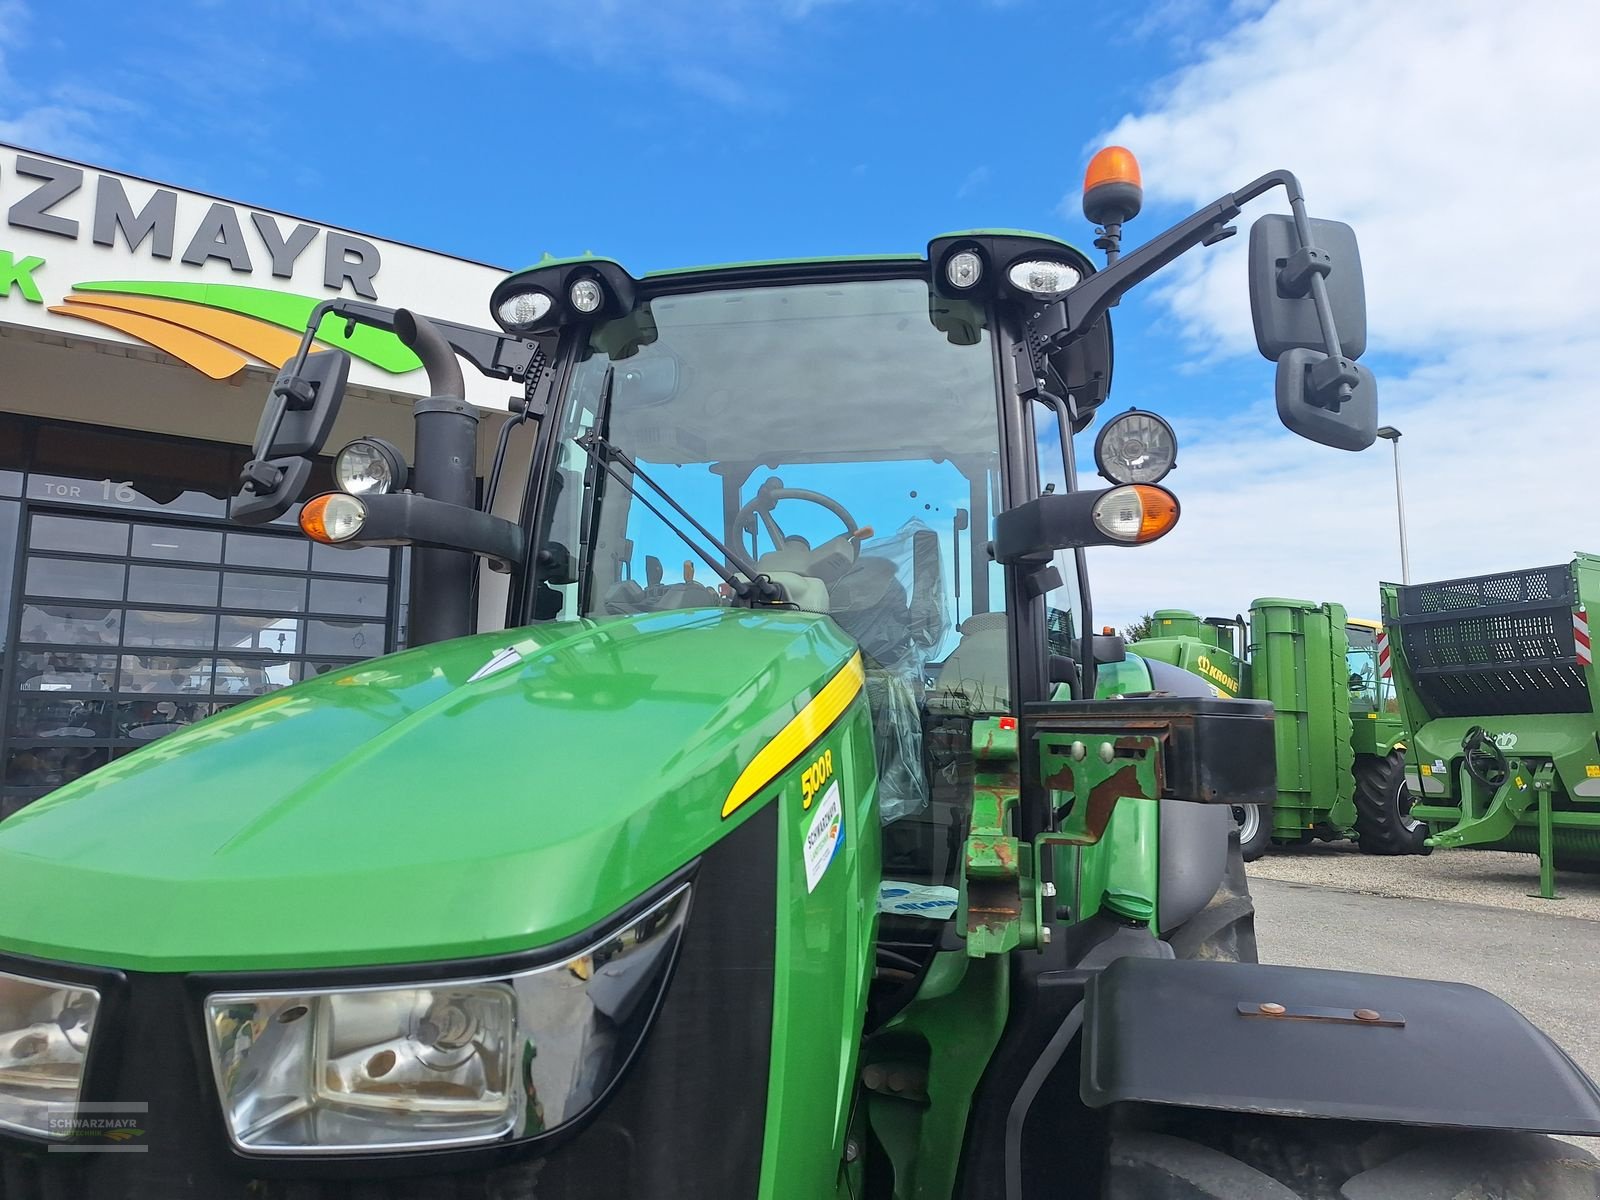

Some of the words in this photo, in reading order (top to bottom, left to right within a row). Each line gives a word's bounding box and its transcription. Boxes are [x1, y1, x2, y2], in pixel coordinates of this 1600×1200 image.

[0, 154, 381, 300] ZMAYR
[44, 482, 81, 498] TOR
[101, 478, 136, 503] 16
[1209, 665, 1239, 693] KRONE
[801, 748, 833, 810] 5100R
